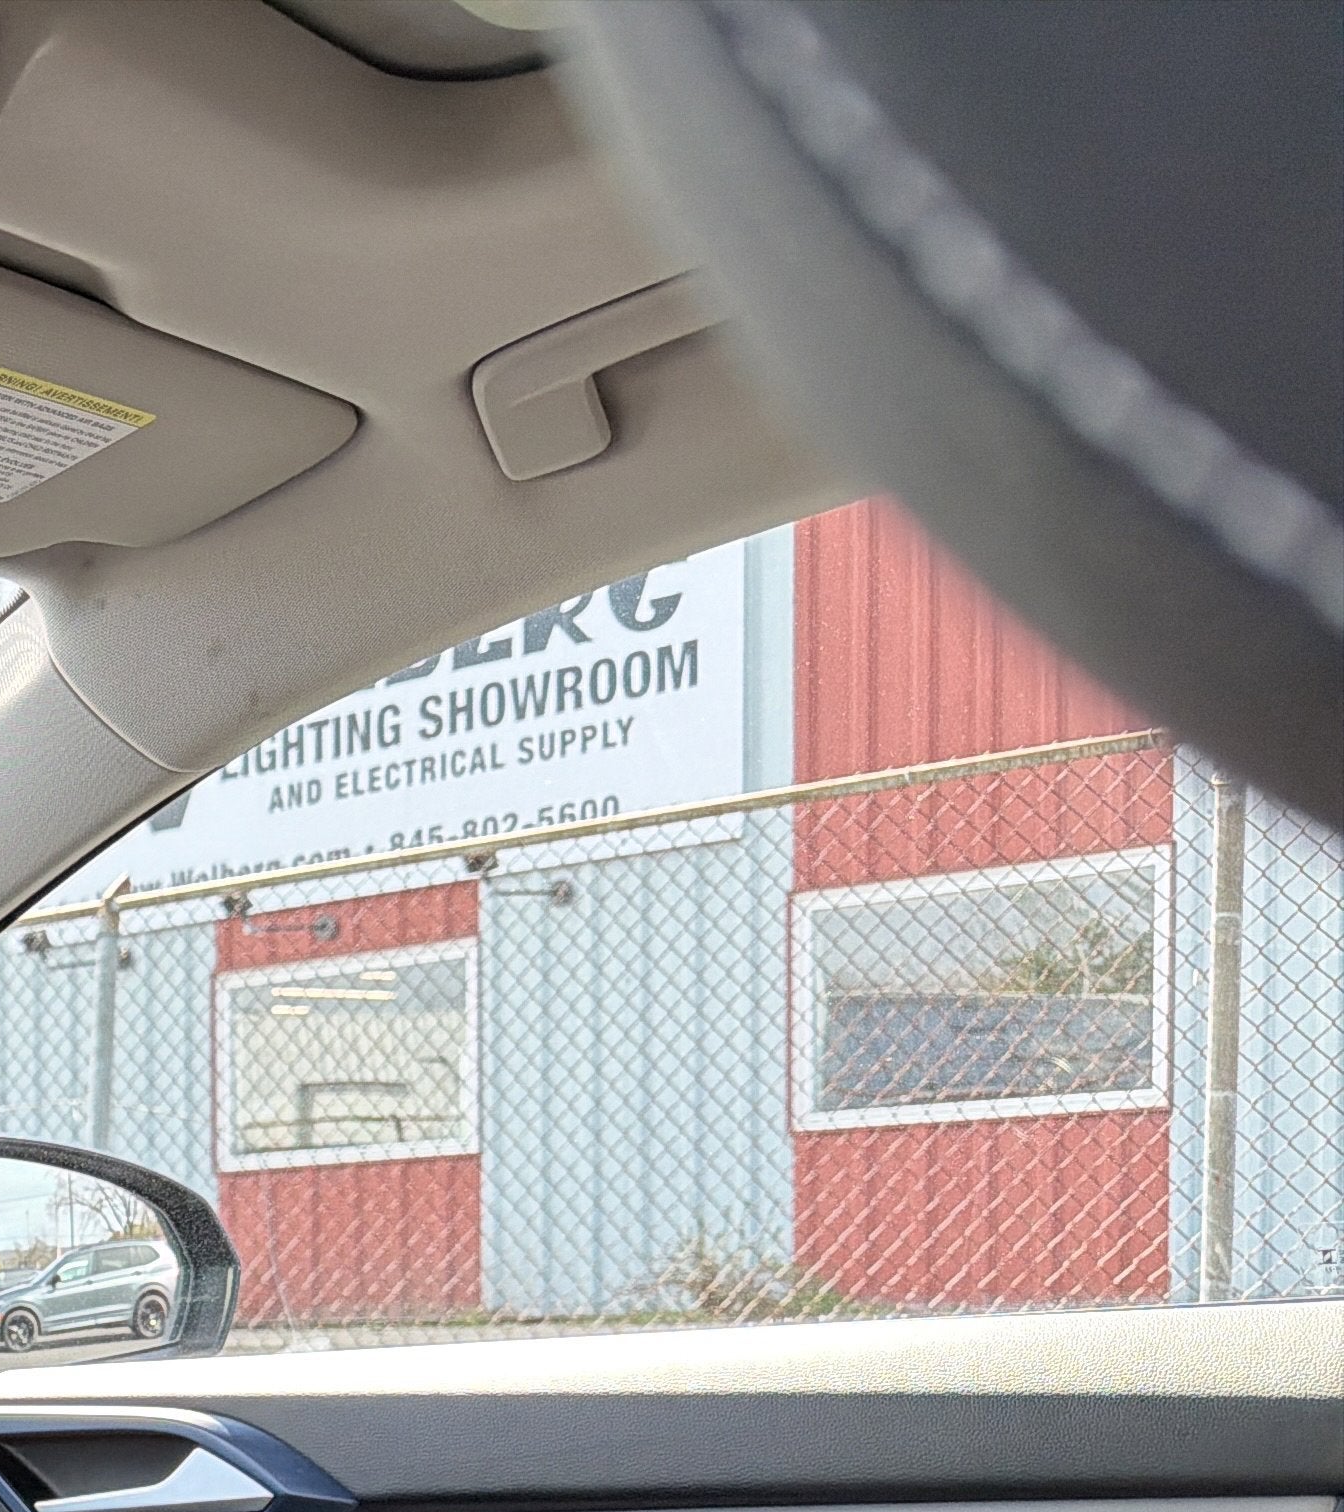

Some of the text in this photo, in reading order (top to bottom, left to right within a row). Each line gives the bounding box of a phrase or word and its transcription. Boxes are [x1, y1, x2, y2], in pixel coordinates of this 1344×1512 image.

[42, 388, 144, 424] AVERTISSEMENT!
[419, 639, 699, 738] SHOWROOM
[269, 717, 634, 812] AND ELECTRICAL SUPPLY
